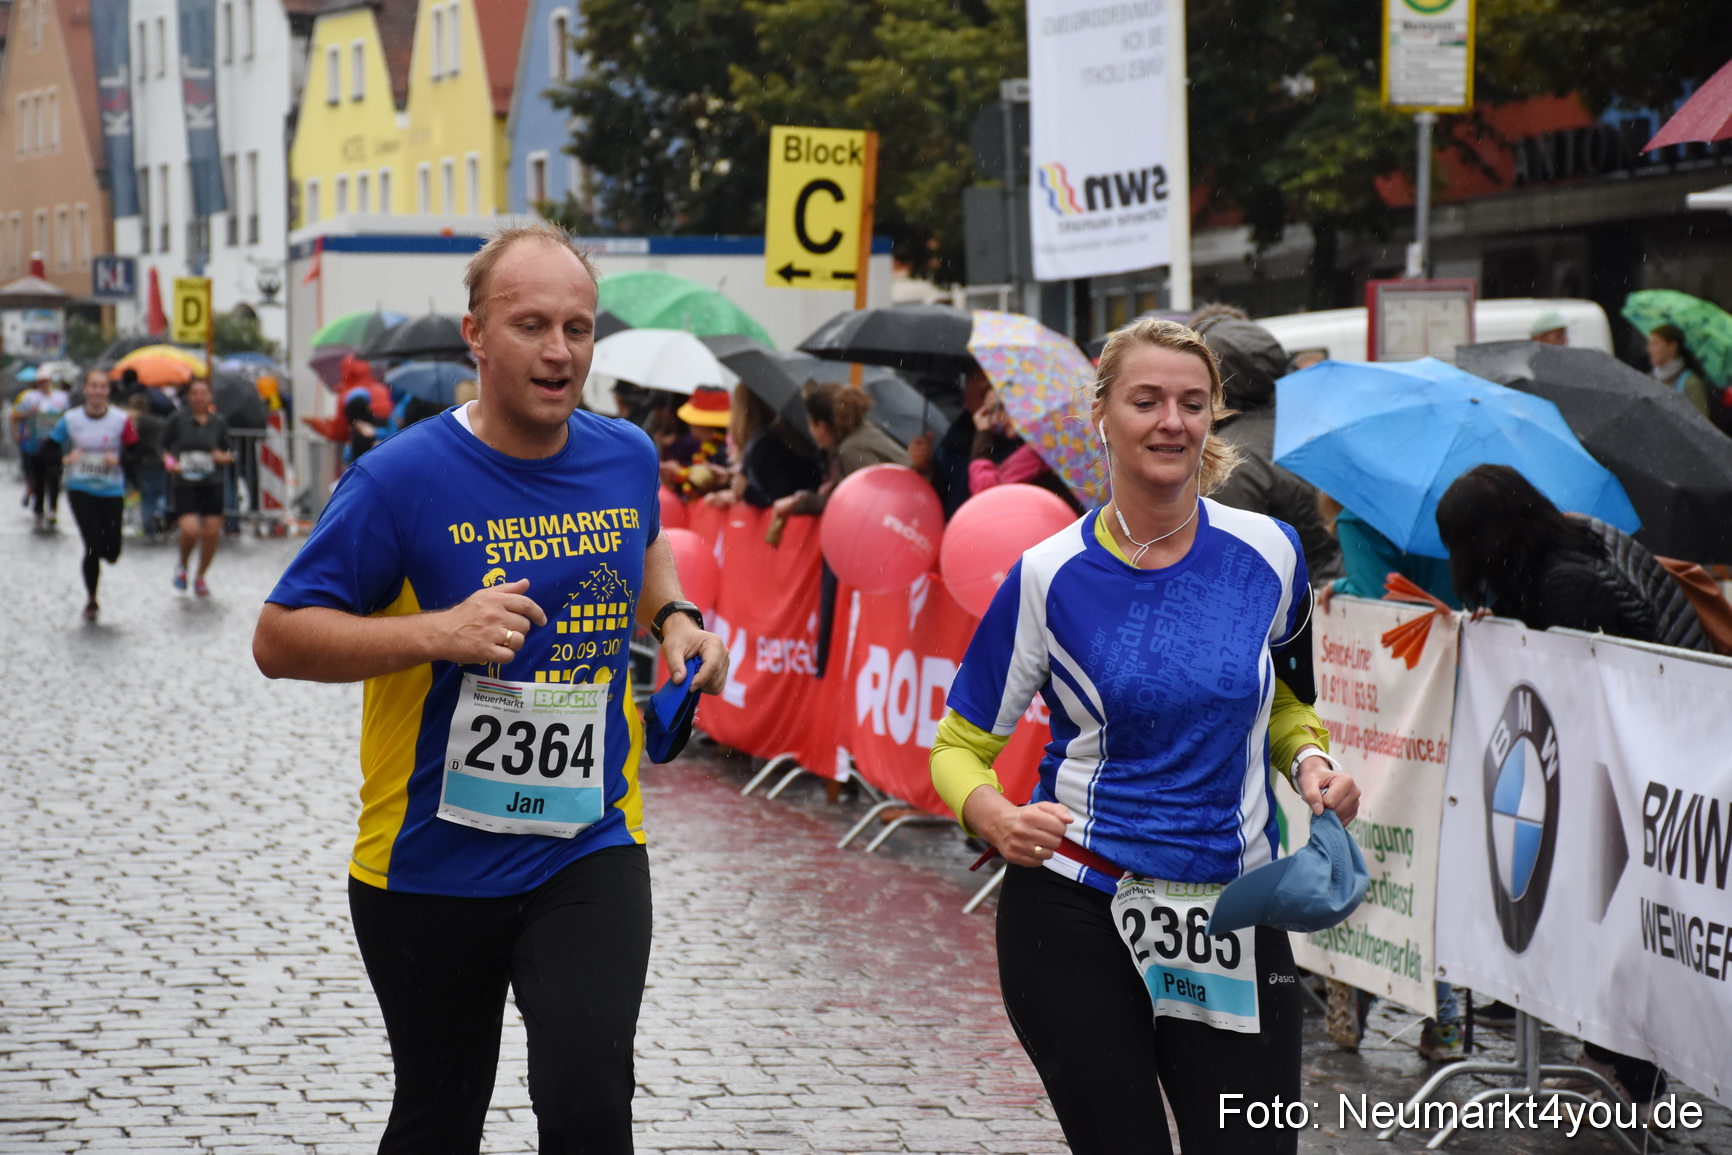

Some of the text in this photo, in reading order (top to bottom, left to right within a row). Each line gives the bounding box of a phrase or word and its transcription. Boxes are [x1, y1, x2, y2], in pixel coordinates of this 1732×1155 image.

[784, 135, 863, 167] Block
[794, 176, 846, 256] C
[182, 296, 201, 327] D
[448, 508, 640, 545] 10. NEUMARKTER
[485, 531, 622, 565] STADTLAUF
[473, 692, 525, 709] NeuerMarkt
[533, 689, 599, 708] BOCK
[464, 714, 595, 778] 2364
[1490, 691, 1558, 782] BMW
[506, 791, 545, 815] Jan
[1643, 780, 1732, 891] BMW
[1165, 881, 1223, 898] BOC
[1122, 906, 1241, 970] 2365
[1163, 972, 1206, 1003] Petra
